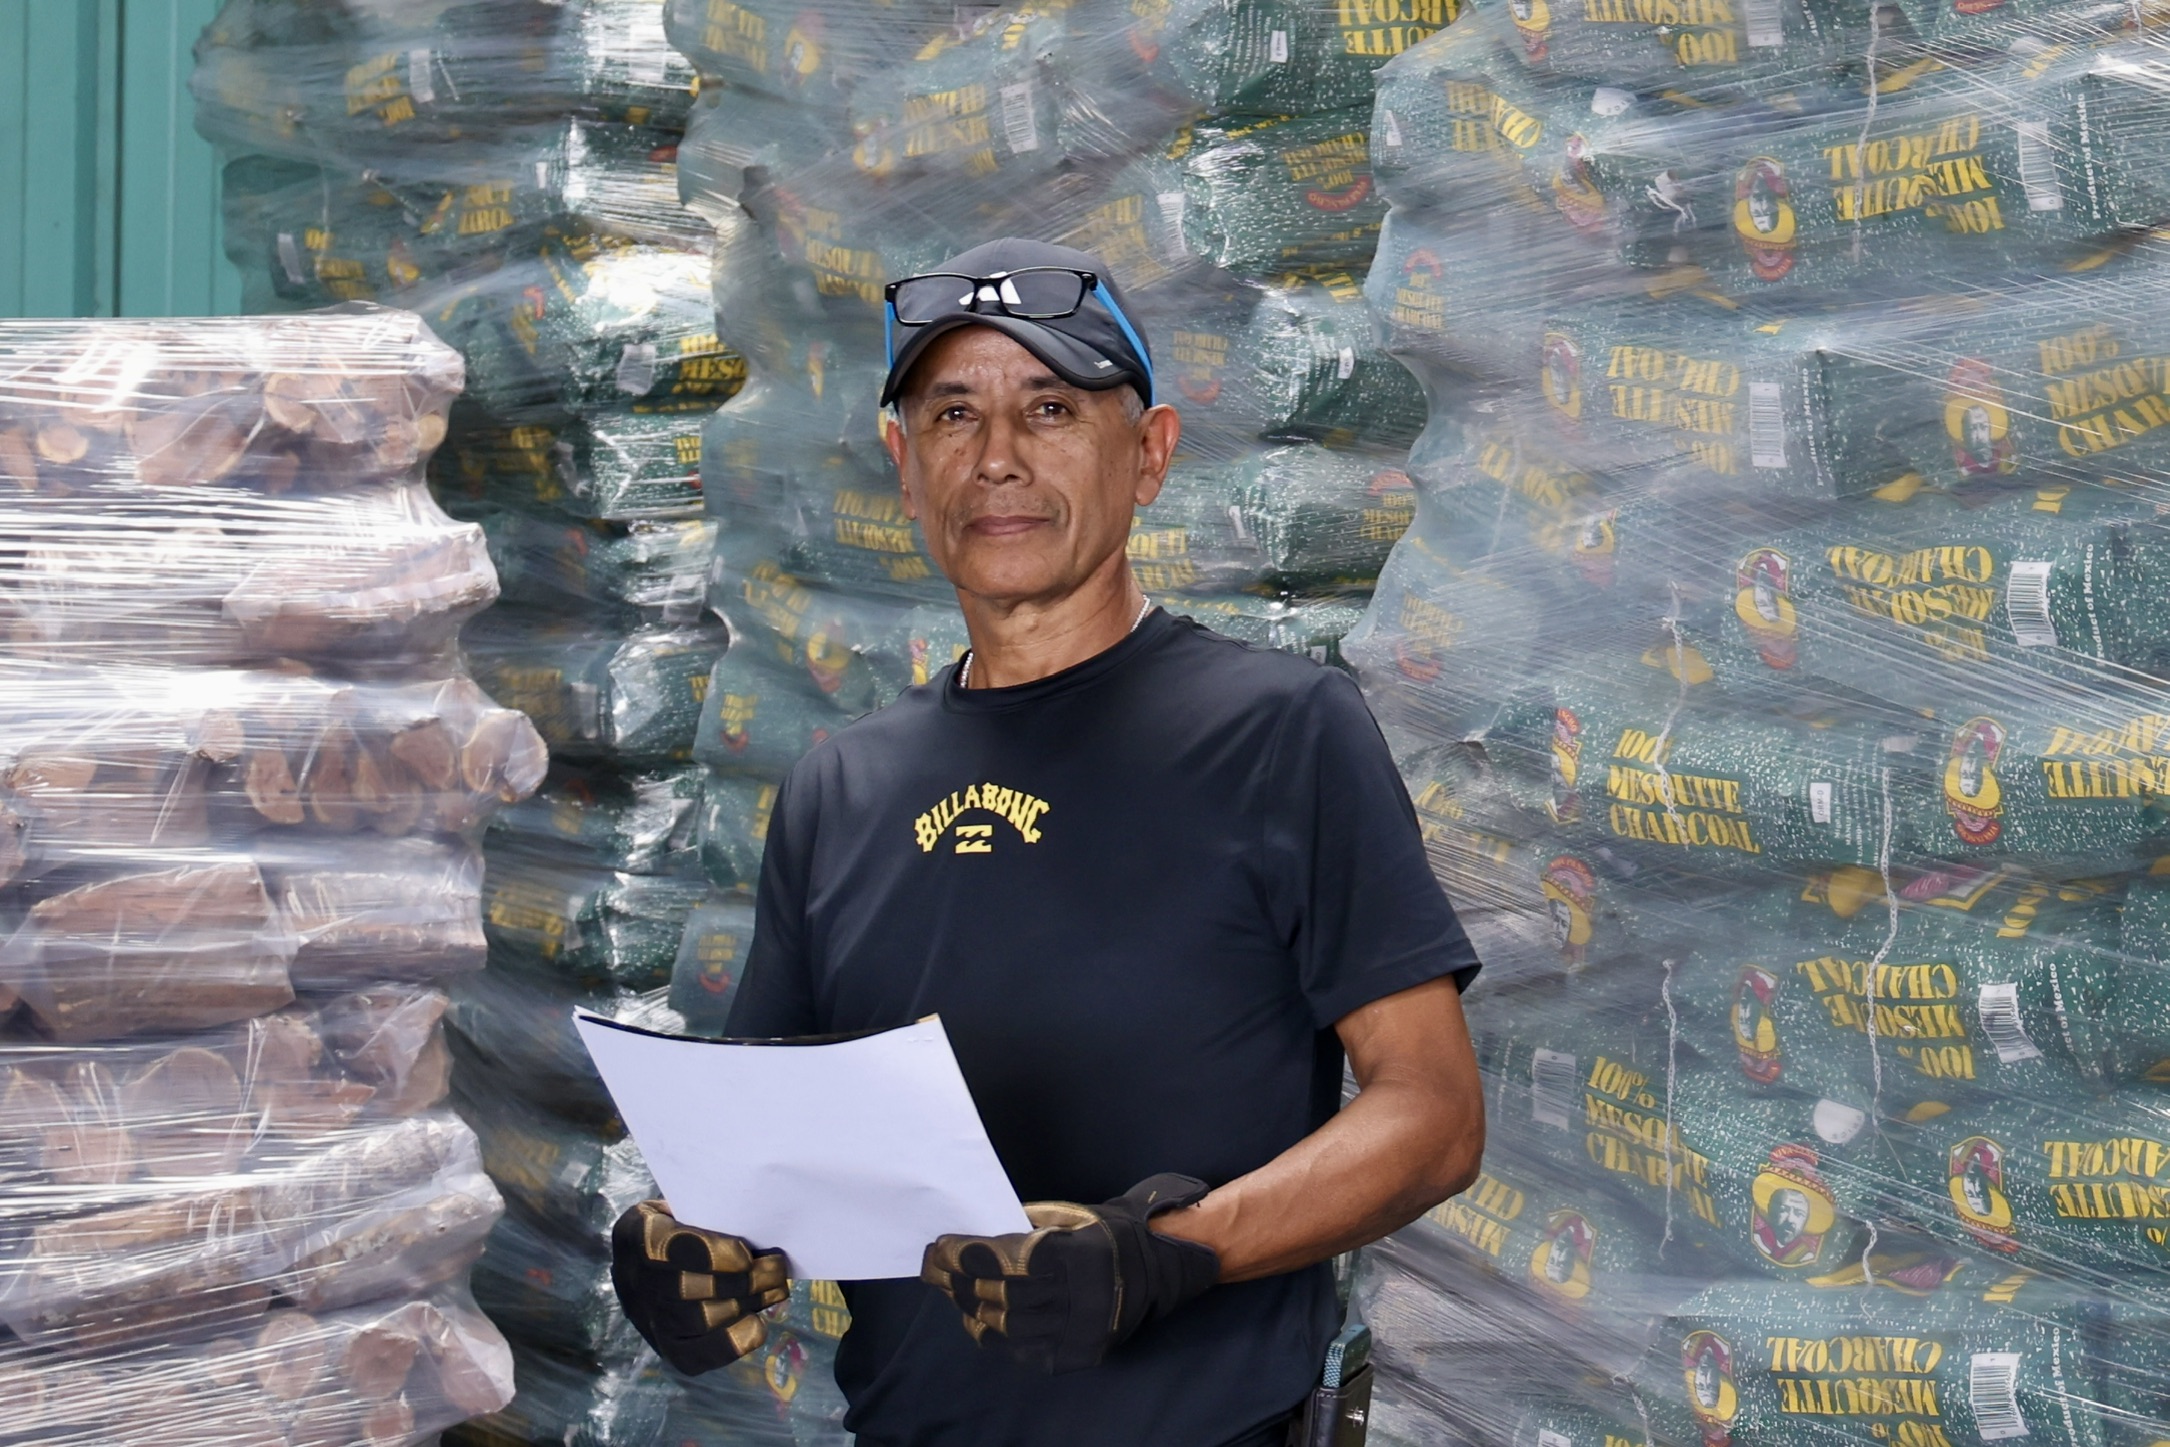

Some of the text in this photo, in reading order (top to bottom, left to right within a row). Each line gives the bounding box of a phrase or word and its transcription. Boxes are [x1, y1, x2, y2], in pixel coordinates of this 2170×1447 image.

[1824, 115, 1980, 181] CHRCOAL
[2077, 93, 2101, 220] Product of Mexico
[1607, 346, 1740, 397] CHAOAL
[1802, 367, 1811, 416] Mexico
[1609, 384, 1735, 435] MESITE
[1804, 419, 1814, 432] of
[2081, 543, 2094, 594] Mexico
[2083, 597, 2093, 611] of
[1613, 728, 1674, 765] 100
[1606, 764, 1743, 814] MESQUITE
[1816, 790, 1824, 816] ORM-D
[914, 782, 1050, 852] BILLABONG
[1610, 802, 1761, 854] CHARCOAL
[2049, 962, 2066, 1012] Mexico
[1586, 1056, 1655, 1109] 100%
[1585, 1094, 1710, 1188] MESQTE
[2050, 1181, 2170, 1219] SQUITE
[1766, 1335, 1943, 1374] CHARCOAL
[2051, 1327, 2063, 1377] Mexico
[1777, 1378, 1939, 1416] MESQUITE
[2055, 1379, 2066, 1394] of
